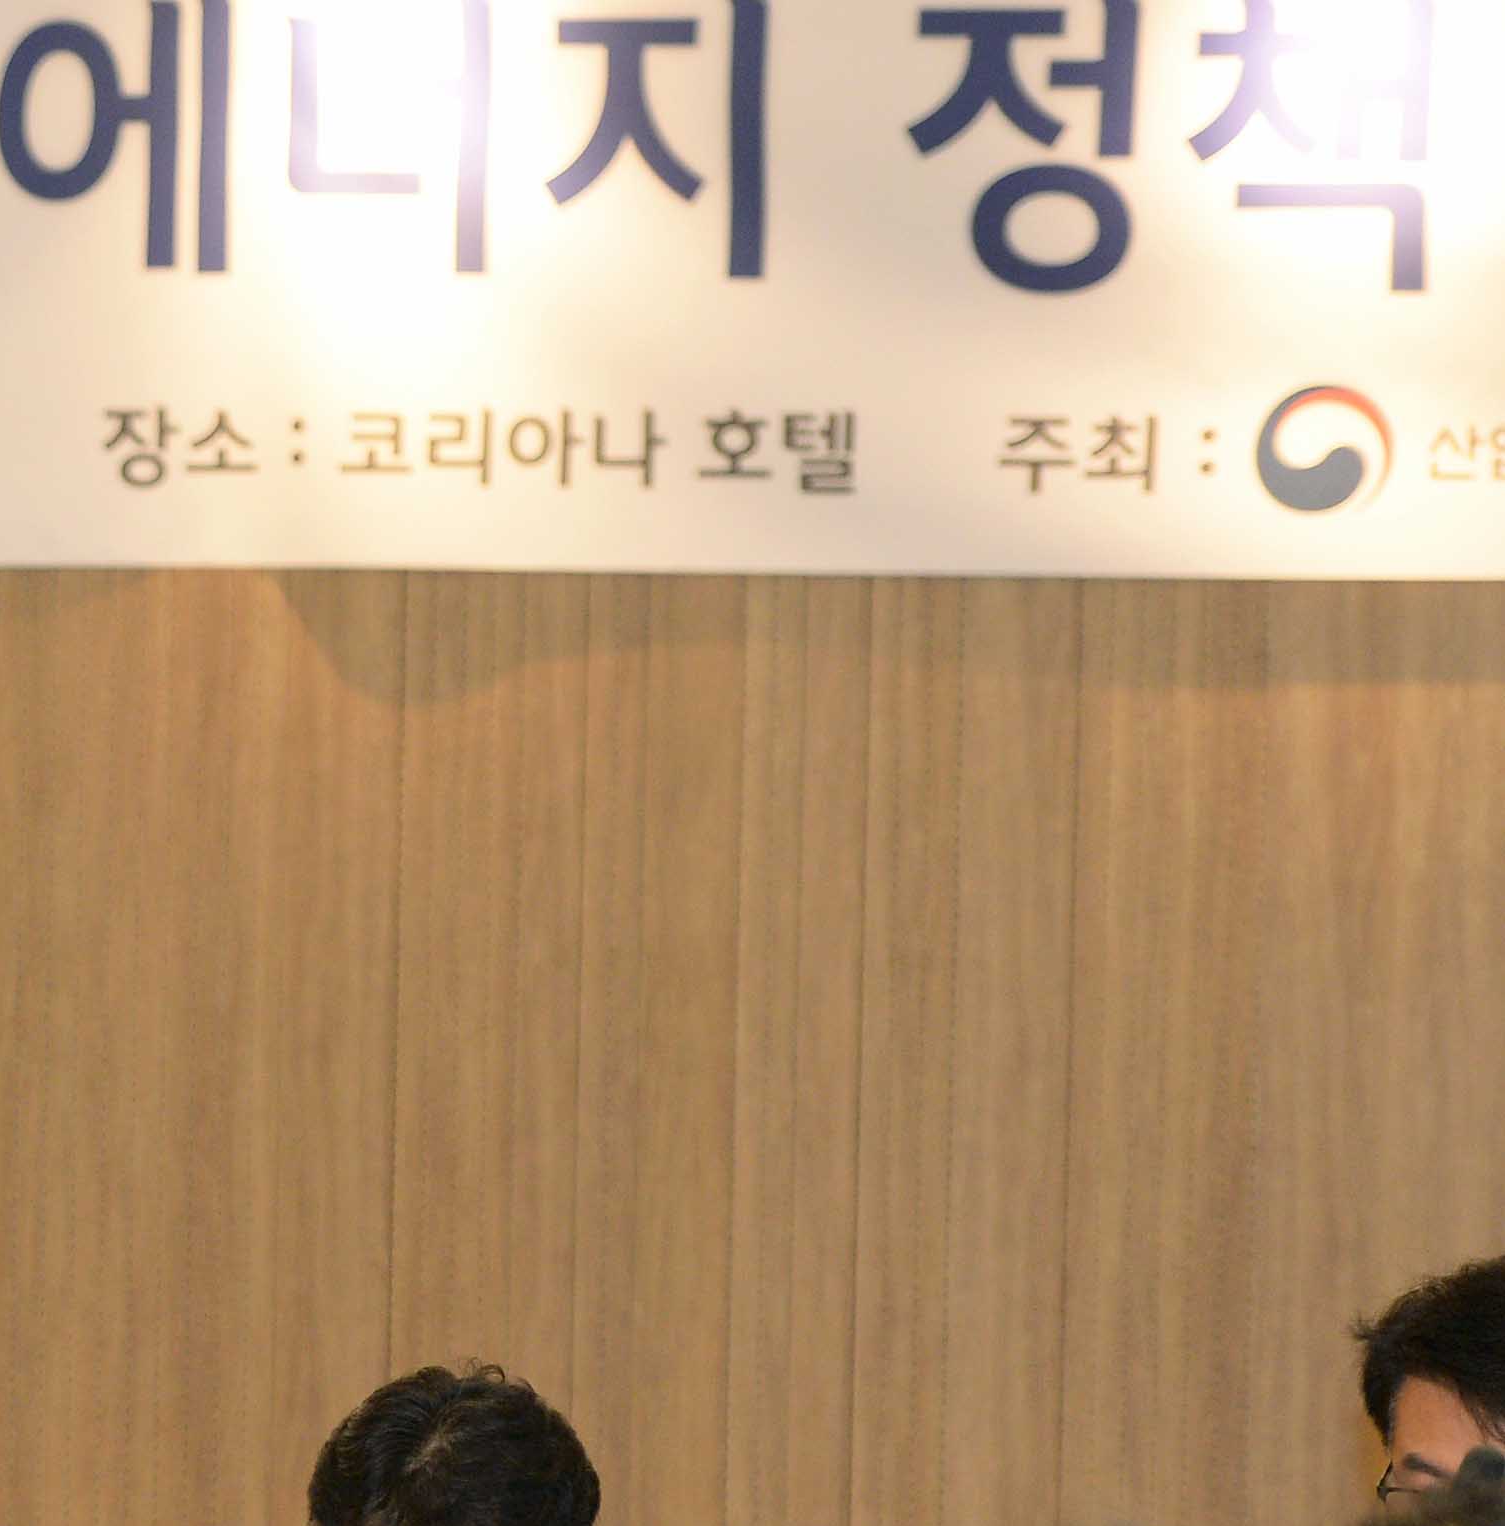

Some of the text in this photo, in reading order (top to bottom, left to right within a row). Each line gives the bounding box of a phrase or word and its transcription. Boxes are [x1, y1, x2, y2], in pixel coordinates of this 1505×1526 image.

[103, 409, 258, 488] 장소
[341, 408, 667, 488] 코리아나
[698, 410, 857, 494] 호텔
[998, 415, 1159, 494] 주최
